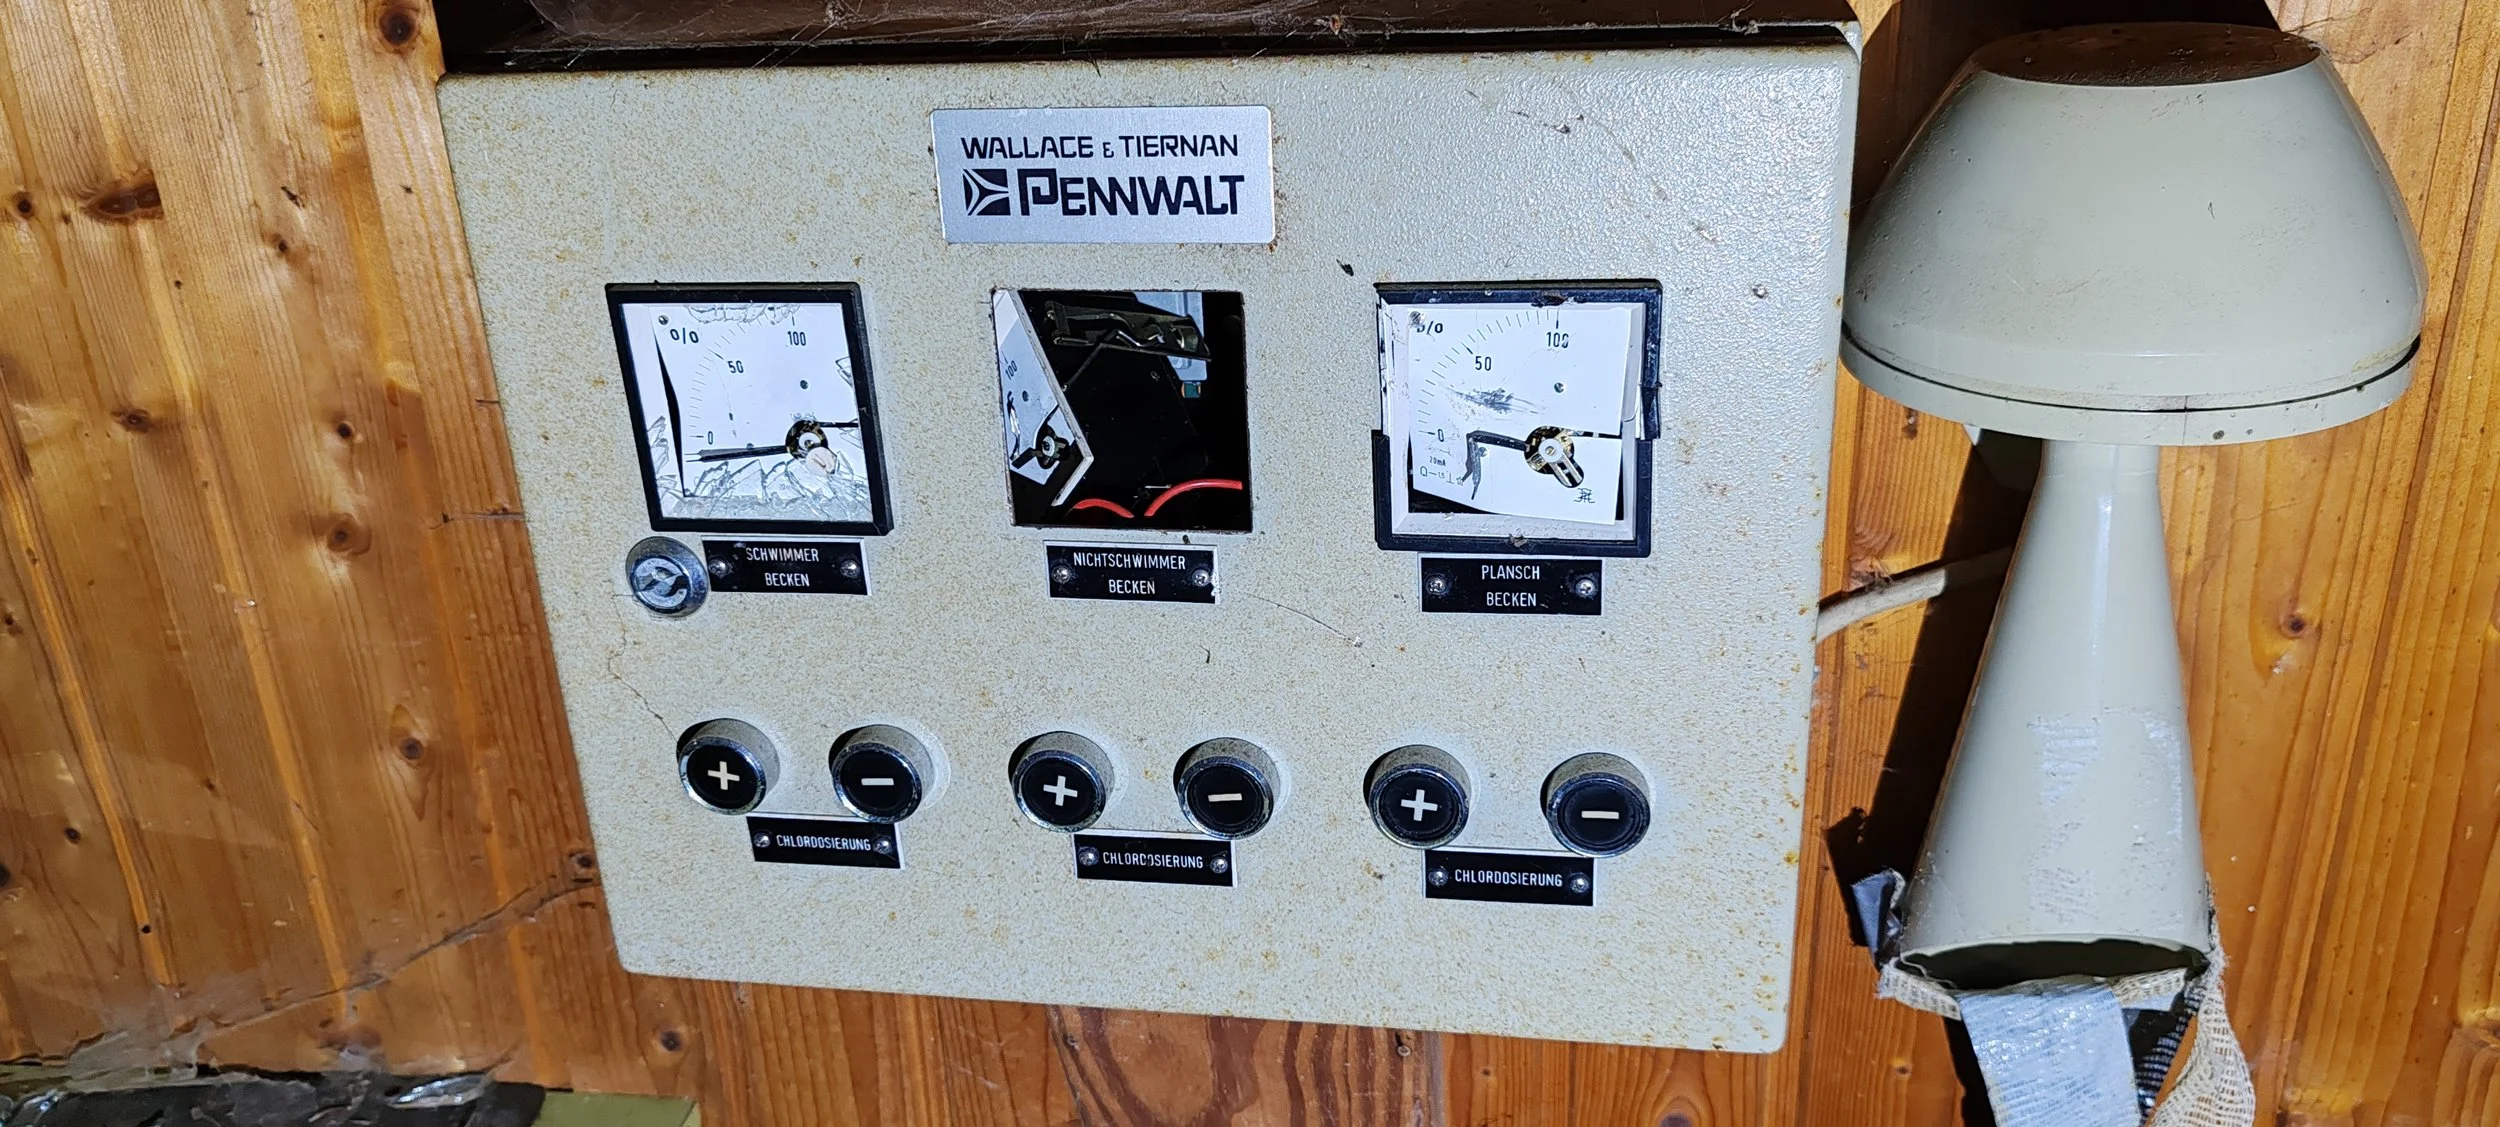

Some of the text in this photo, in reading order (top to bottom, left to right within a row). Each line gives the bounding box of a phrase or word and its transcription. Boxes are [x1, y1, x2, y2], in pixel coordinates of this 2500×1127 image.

[961, 134, 1238, 159] WALLACE & TIERNAN
[1017, 168, 1245, 216] PENNWALT
[787, 330, 807, 347] 100
[1546, 331, 1570, 349] 100
[728, 359, 744, 374] 50
[1005, 360, 1018, 381] 100
[1475, 355, 1492, 371] 50
[707, 431, 714, 445] 0
[1437, 428, 1445, 442] 0
[745, 547, 820, 562] SCHWIMMER
[1073, 552, 1186, 570] NICHTSCHWIMMER
[764, 572, 810, 587] BECKEN
[1481, 565, 1540, 580] PLANSCH
[1108, 579, 1156, 595] BECKEN
[1486, 591, 1537, 607] BECKEN
[776, 834, 872, 851] CHLORDOSIERUNG
[1454, 869, 1563, 887] CHLORDOSIERUNG
